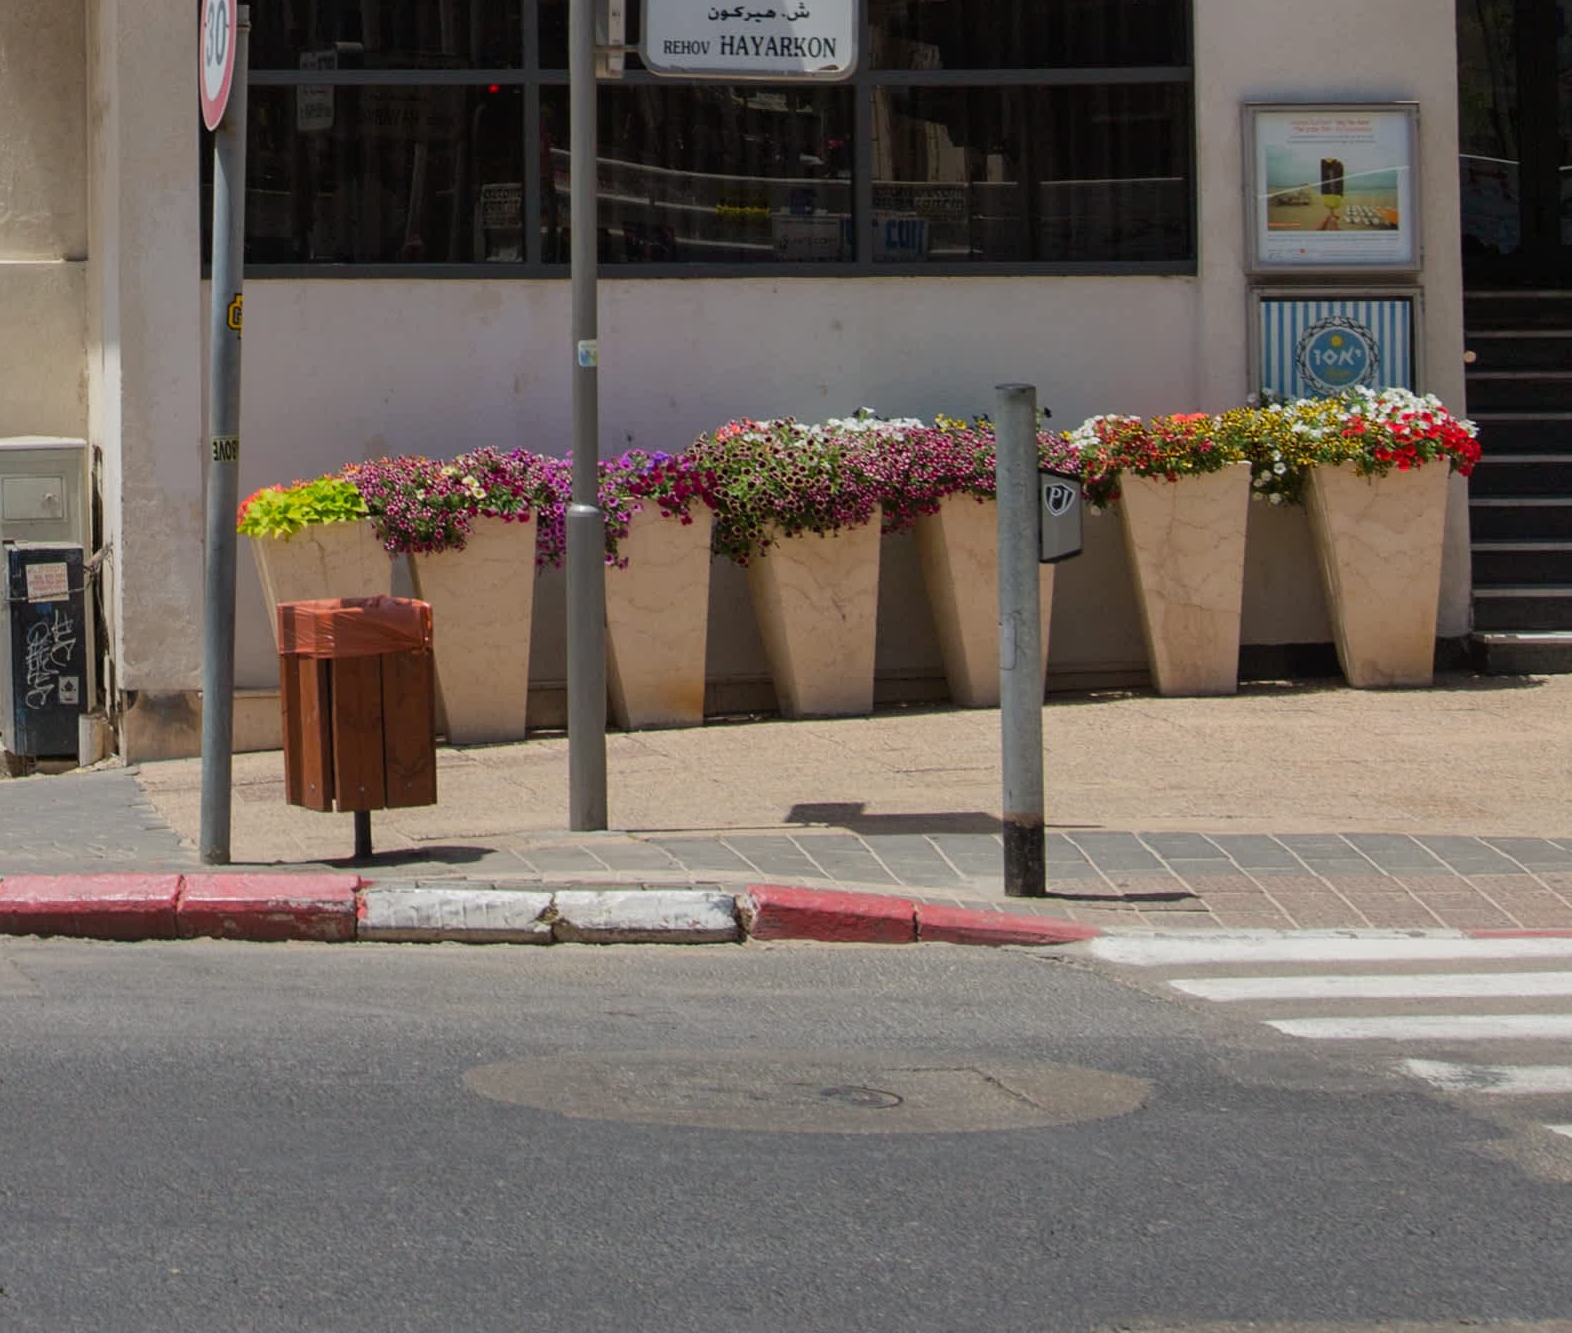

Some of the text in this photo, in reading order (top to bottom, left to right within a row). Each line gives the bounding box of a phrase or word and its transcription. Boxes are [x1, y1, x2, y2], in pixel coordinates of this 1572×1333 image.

[707, 5, 777, 23] هيركون
[206, 0, 227, 67] 30
[662, 35, 838, 59] REHOV HAYARKON
